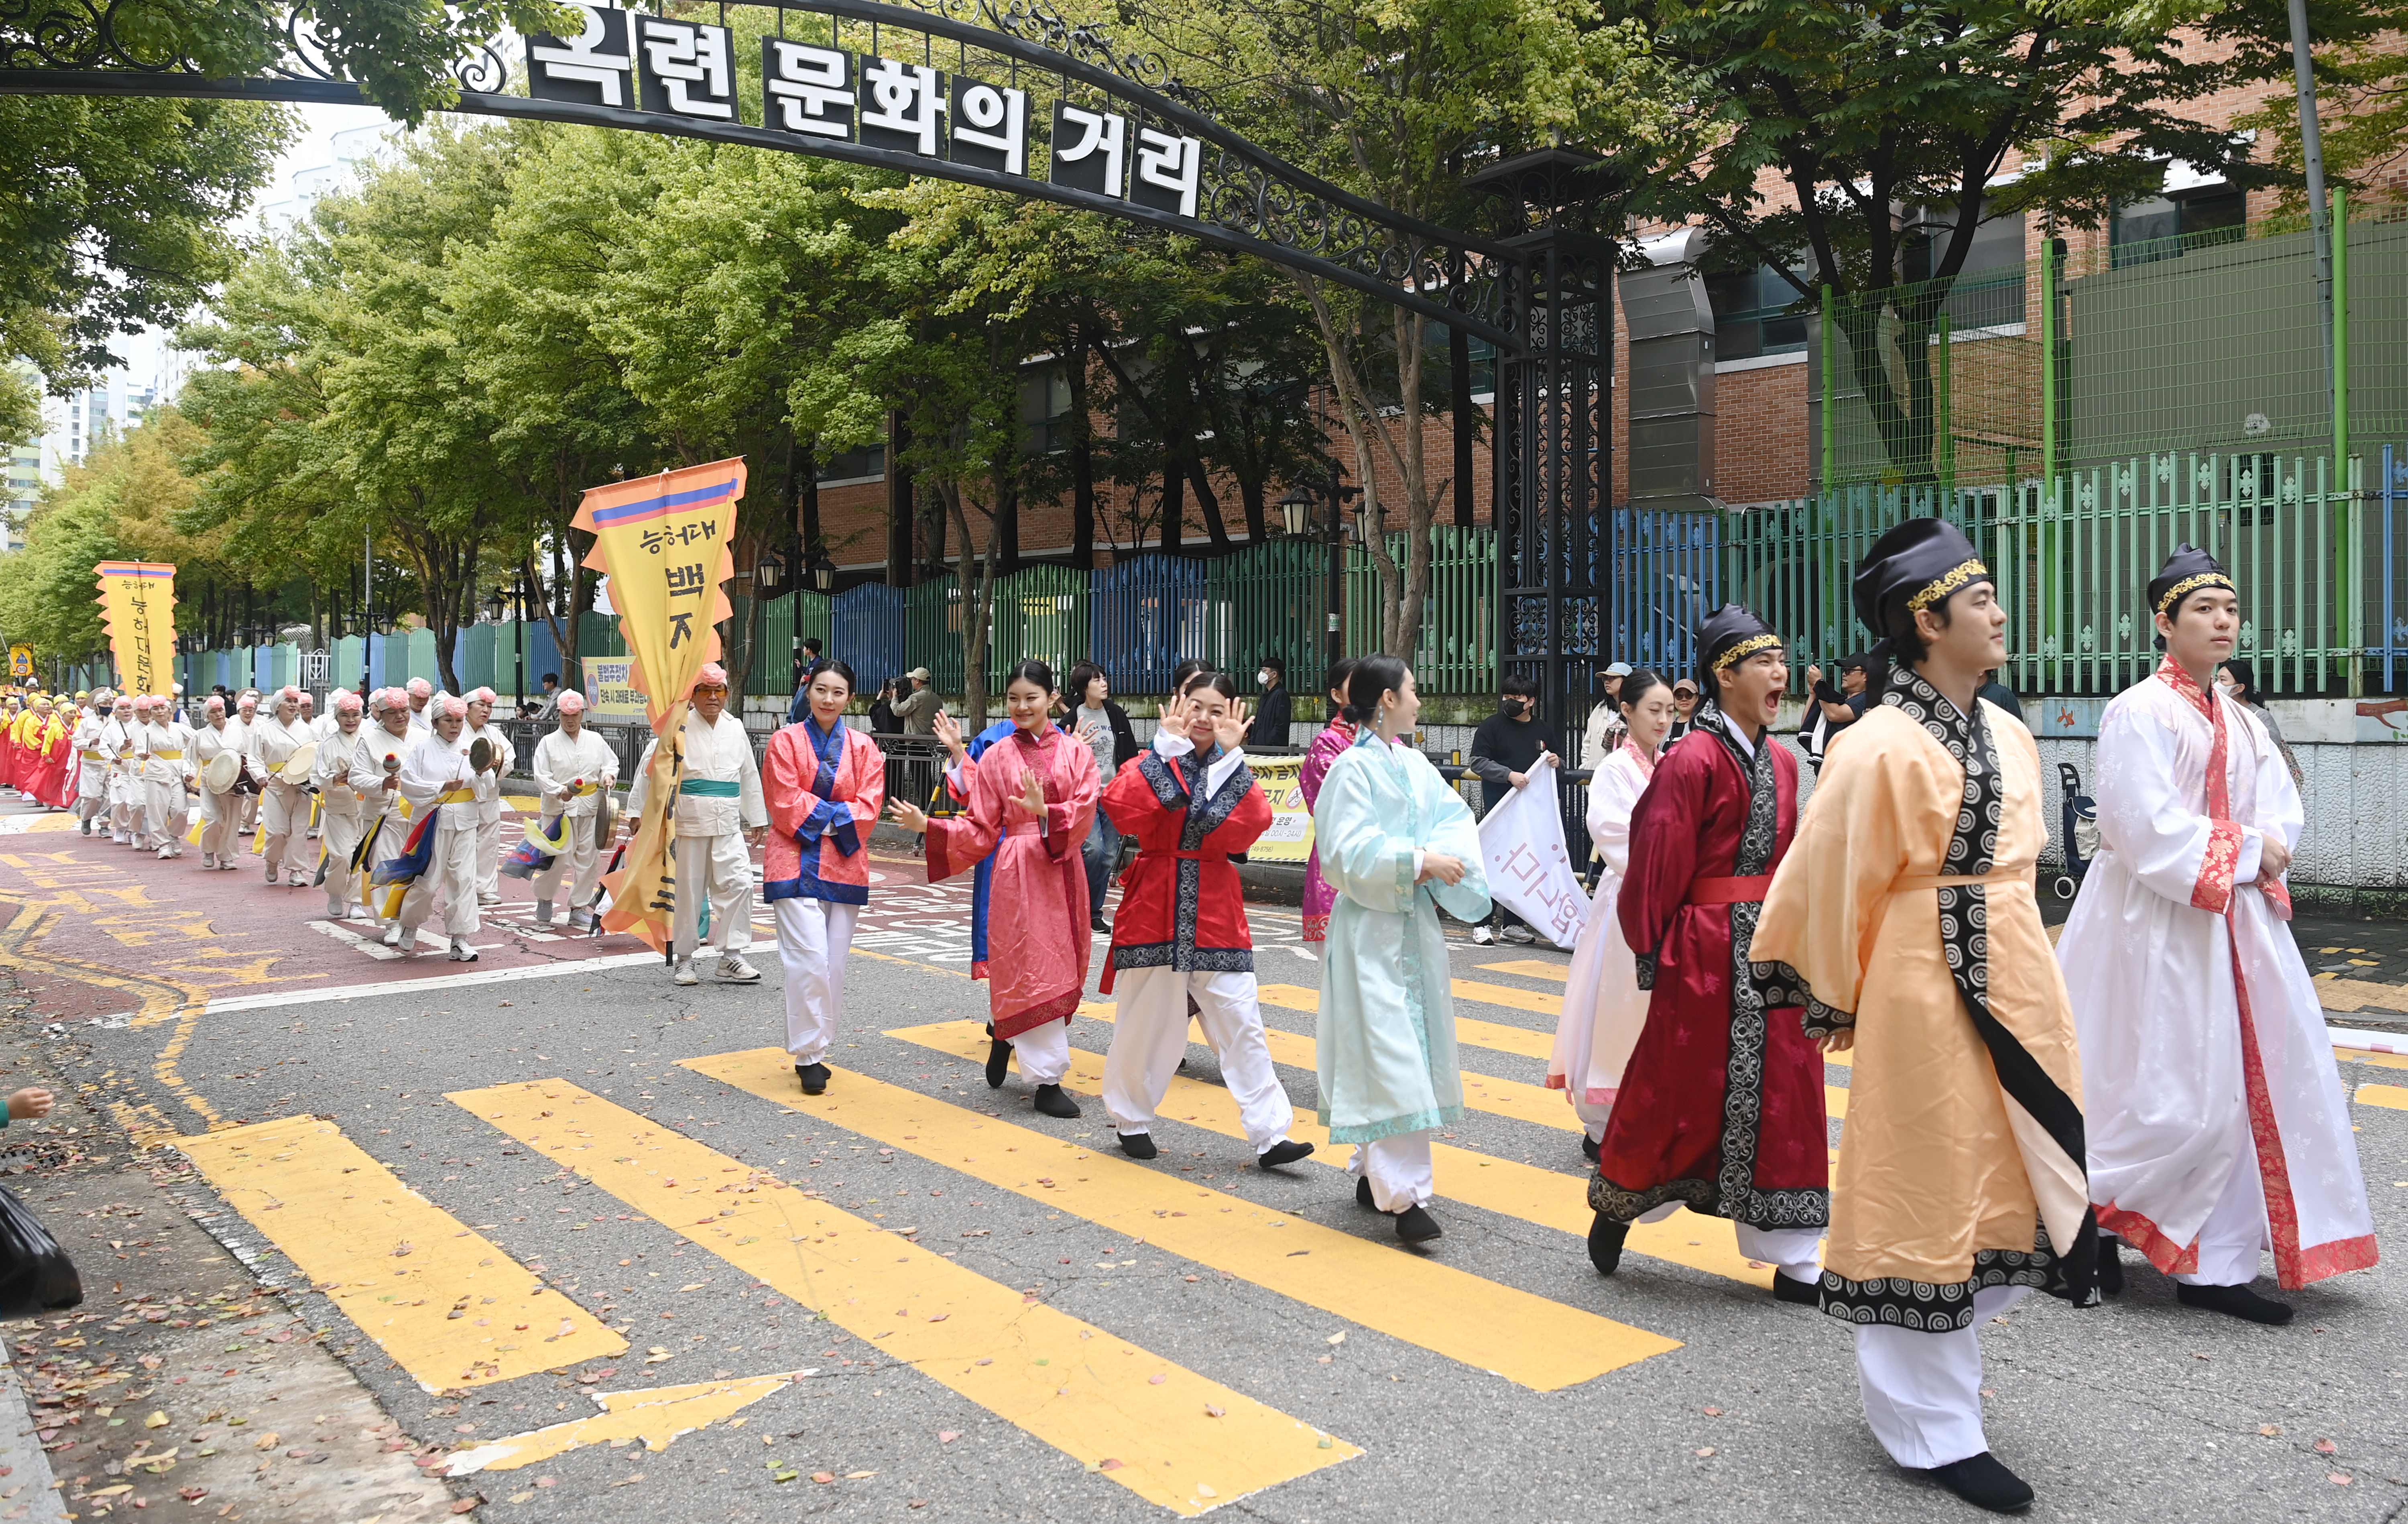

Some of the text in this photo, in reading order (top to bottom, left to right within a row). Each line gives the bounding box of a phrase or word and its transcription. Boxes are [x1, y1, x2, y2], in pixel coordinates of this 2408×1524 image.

[532, 2, 1201, 218] 옥련 문화의 거리
[640, 520, 716, 554] 능허대
[122, 580, 155, 590] 능허대
[131, 596, 151, 697] 능허대문화
[597, 664, 628, 683] 불법주정차
[600, 689, 610, 704] 단속
[610, 690, 615, 704] 시
[630, 690, 651, 704] 부과합니
[1083, 726, 1098, 737] EAM
[1274, 764, 1302, 780] 금지
[1276, 817, 1292, 826] 운영
